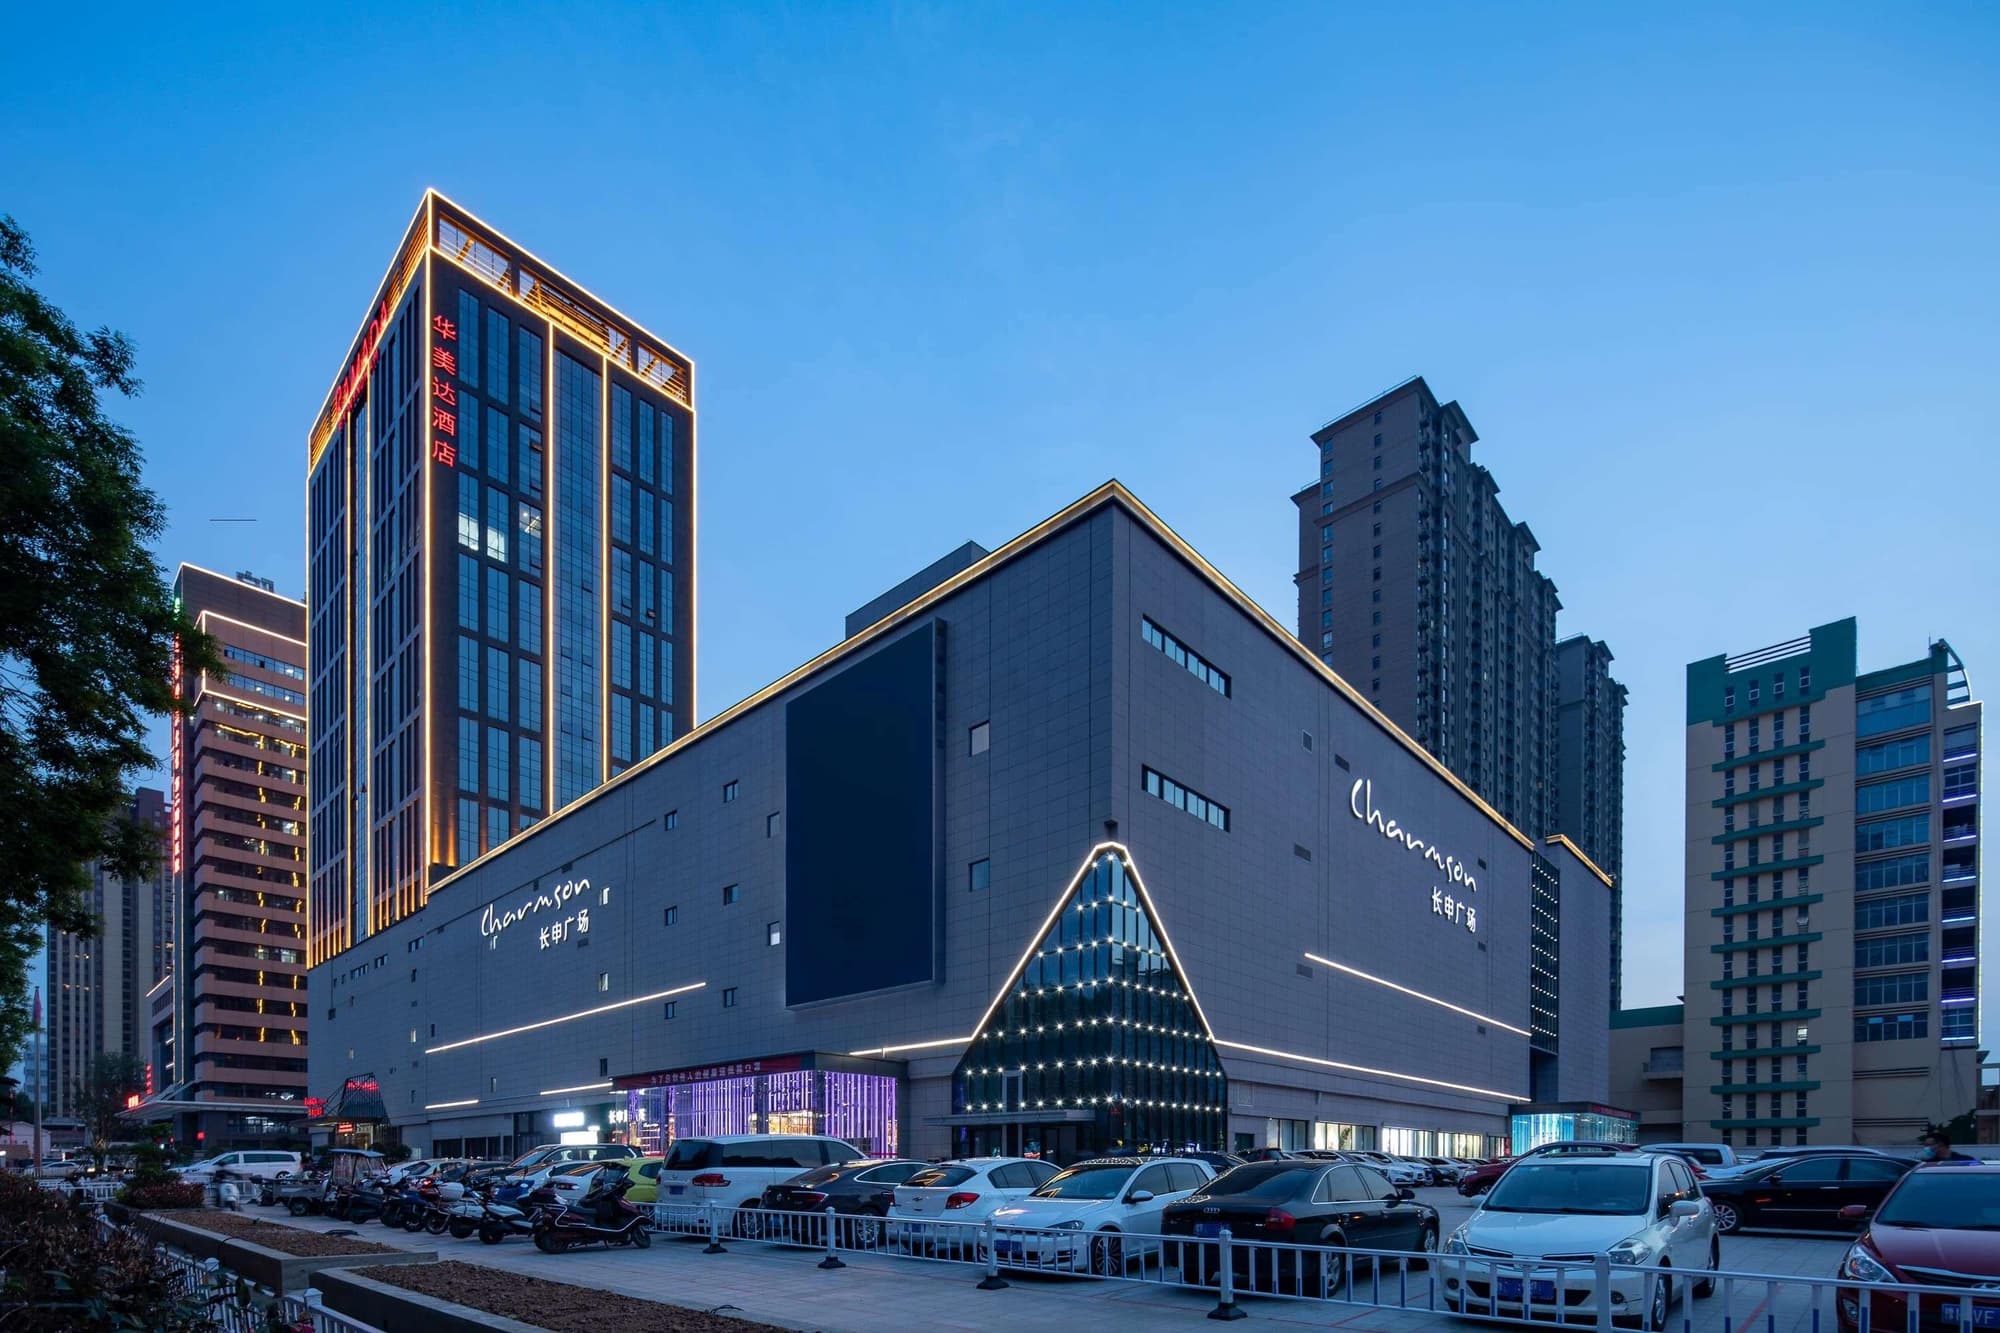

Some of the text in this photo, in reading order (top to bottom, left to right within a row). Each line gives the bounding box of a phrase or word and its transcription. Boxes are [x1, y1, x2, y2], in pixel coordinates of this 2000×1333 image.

[431, 314, 457, 468] 华美达酒店
[1351, 778, 1477, 892] Charmson
[481, 878, 591, 937] Charmson
[539, 908, 590, 951] 长申广场
[1431, 885, 1477, 934] 长申广场
